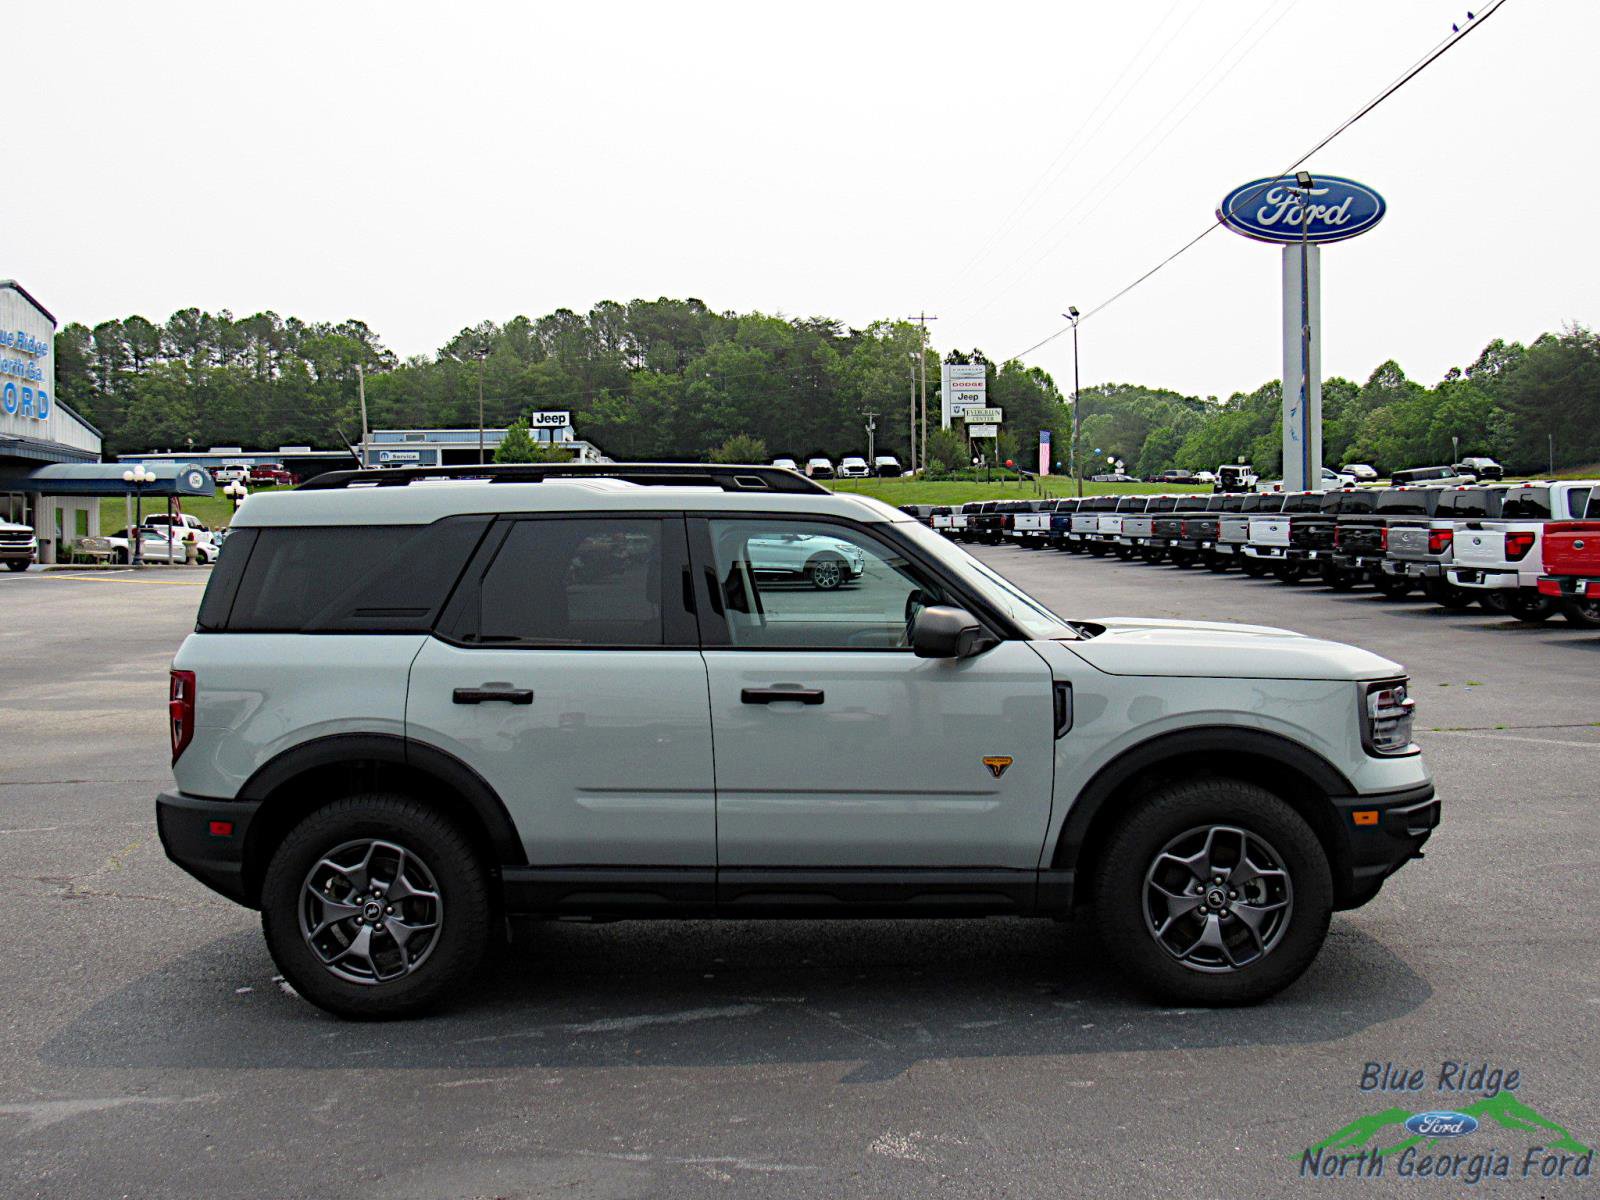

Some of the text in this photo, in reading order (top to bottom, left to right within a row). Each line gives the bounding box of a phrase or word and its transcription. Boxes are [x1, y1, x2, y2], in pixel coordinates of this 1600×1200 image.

[1257, 186, 1353, 225] Ford
[17, 331, 48, 358] Ridge
[957, 393, 979, 402] Jeep
[536, 413, 566, 425] Jeep
